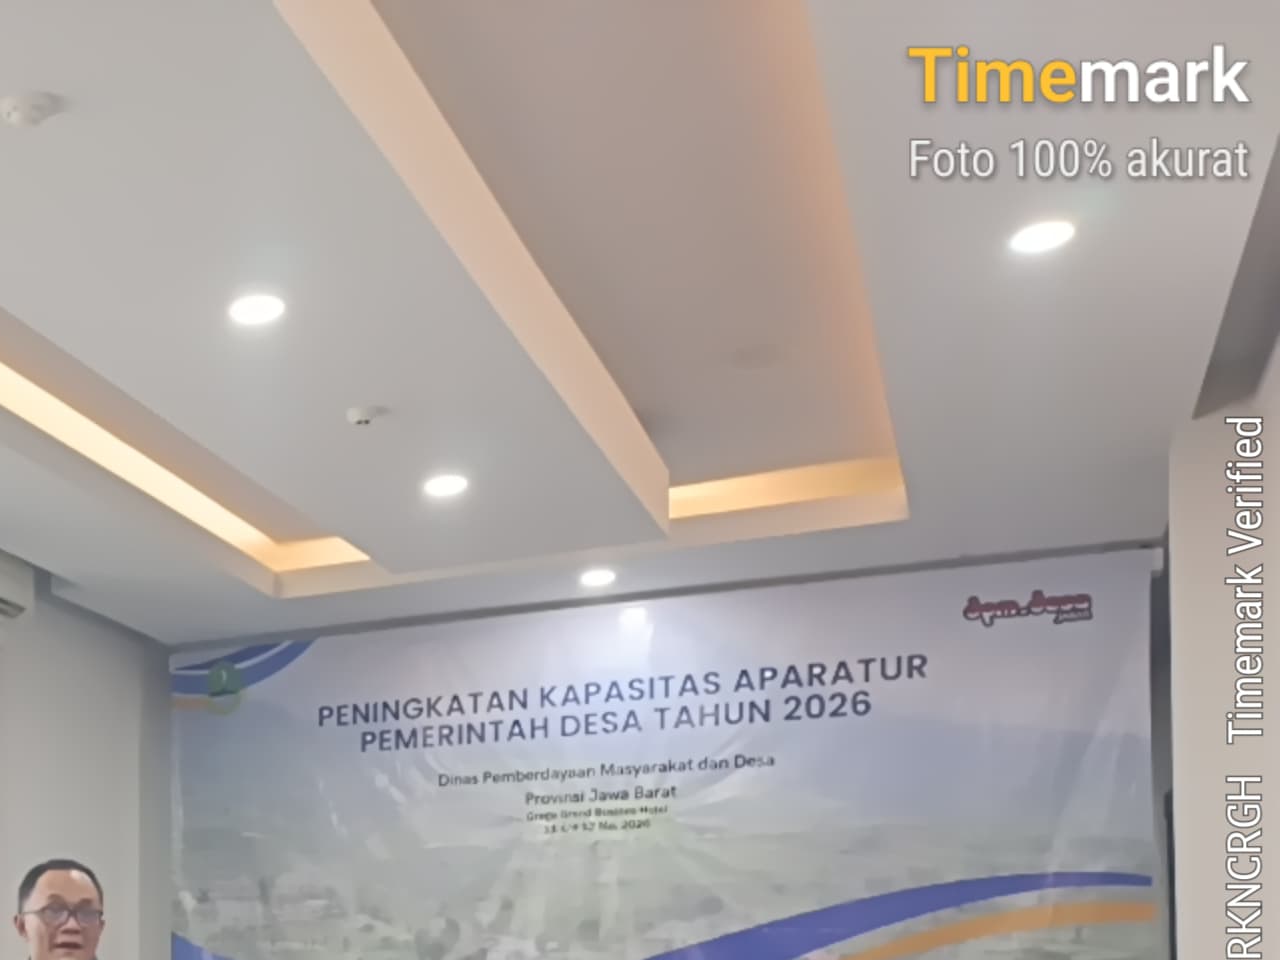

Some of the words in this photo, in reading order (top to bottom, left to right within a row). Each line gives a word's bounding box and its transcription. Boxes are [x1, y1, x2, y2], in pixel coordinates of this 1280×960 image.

[318, 688, 528, 727] PENINGKATAN
[539, 671, 721, 707] KAPASITAS
[733, 654, 928, 693] APARATUR
[360, 716, 549, 752] PEMERINTAH
[560, 709, 642, 738] DESA
[654, 699, 771, 730] TAHUN
[783, 690, 872, 721] 2026
[438, 773, 478, 787] Dinas
[482, 766, 595, 784] Pemberdayaan
[600, 759, 693, 778] Masyarakat
[698, 756, 729, 771] dan
[734, 753, 776, 769] Desa
[525, 791, 584, 805] Provinsi
[589, 788, 629, 802] Jawa
[634, 785, 676, 799] Barat
